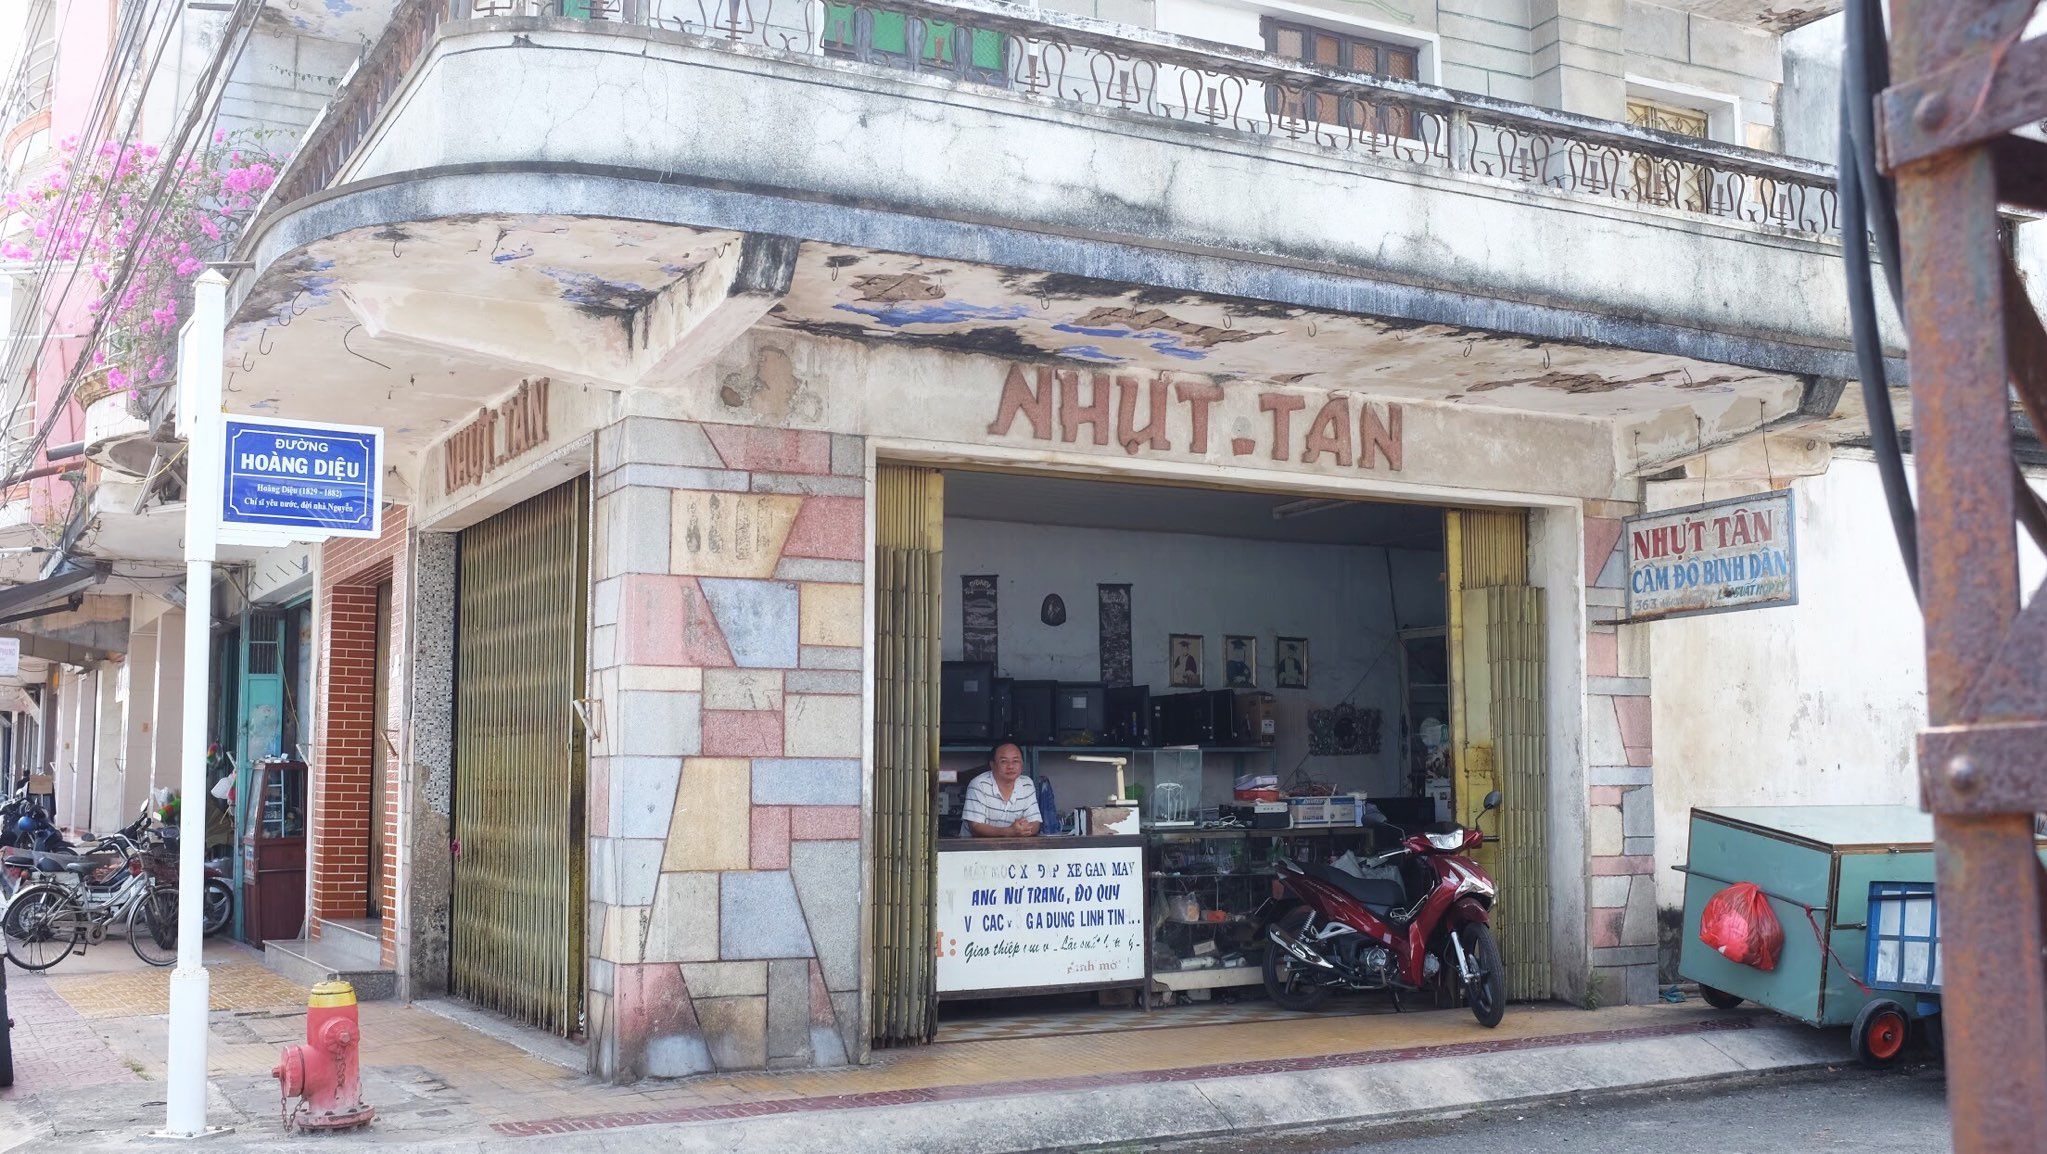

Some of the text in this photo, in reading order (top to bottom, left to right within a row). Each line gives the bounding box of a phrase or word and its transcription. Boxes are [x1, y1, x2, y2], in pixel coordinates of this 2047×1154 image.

[275, 438, 329, 453] ĐƯỜNG
[241, 451, 359, 480] HOÀNG DIỆU
[257, 484, 280, 494] Hoàng
[282, 486, 298, 495] Diệu
[244, 497, 257, 505] Chí
[266, 499, 278, 508] yêu
[1633, 508, 1773, 561] NHỰT TÂN
[1749, 546, 1787, 579] DÂN
[1080, 909, 1104, 926] LINH
[965, 942, 990, 963] Giao
